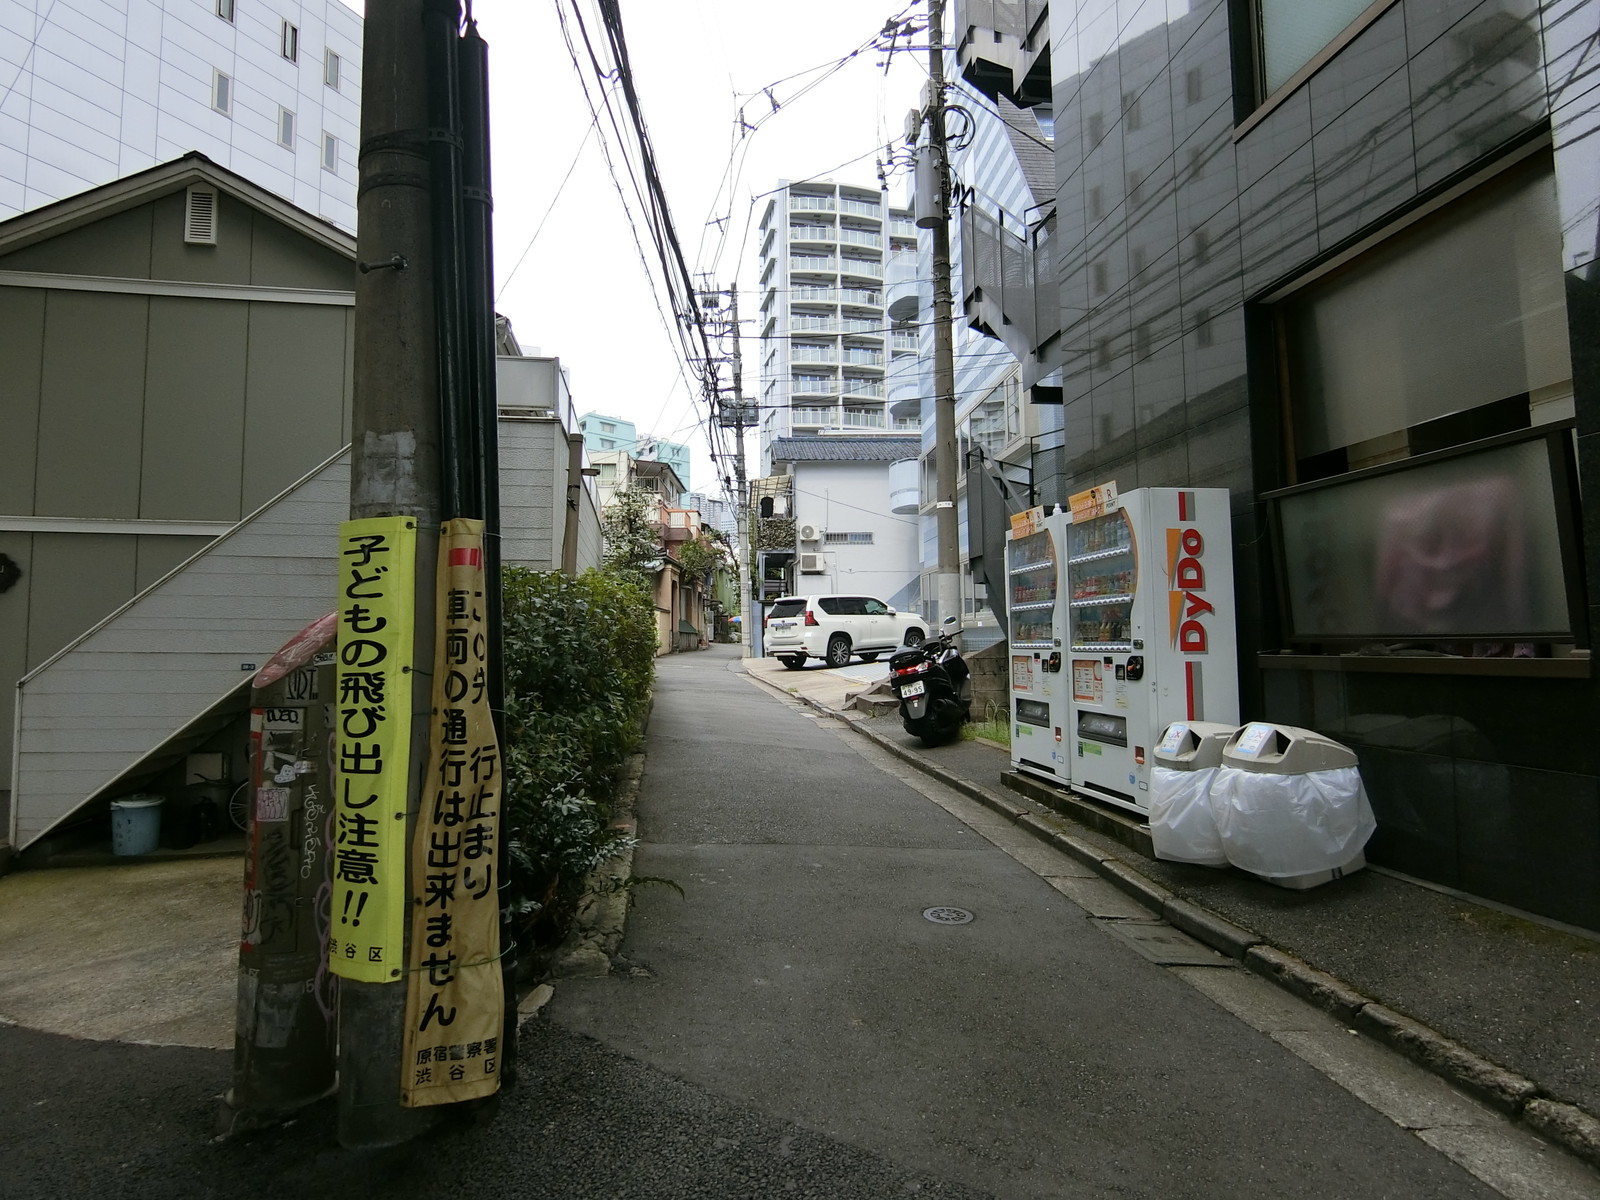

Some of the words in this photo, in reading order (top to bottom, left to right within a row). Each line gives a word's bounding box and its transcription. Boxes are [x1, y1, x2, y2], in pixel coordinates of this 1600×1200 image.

[1177, 528, 1215, 652] DyDo
[337, 535, 389, 927] 子どもの飛び出し注意!!
[903, 685, 923, 697] 49-95
[419, 588, 469, 1032] 車両の通行は出来ません
[416, 1057, 496, 1086] 渋谷区
